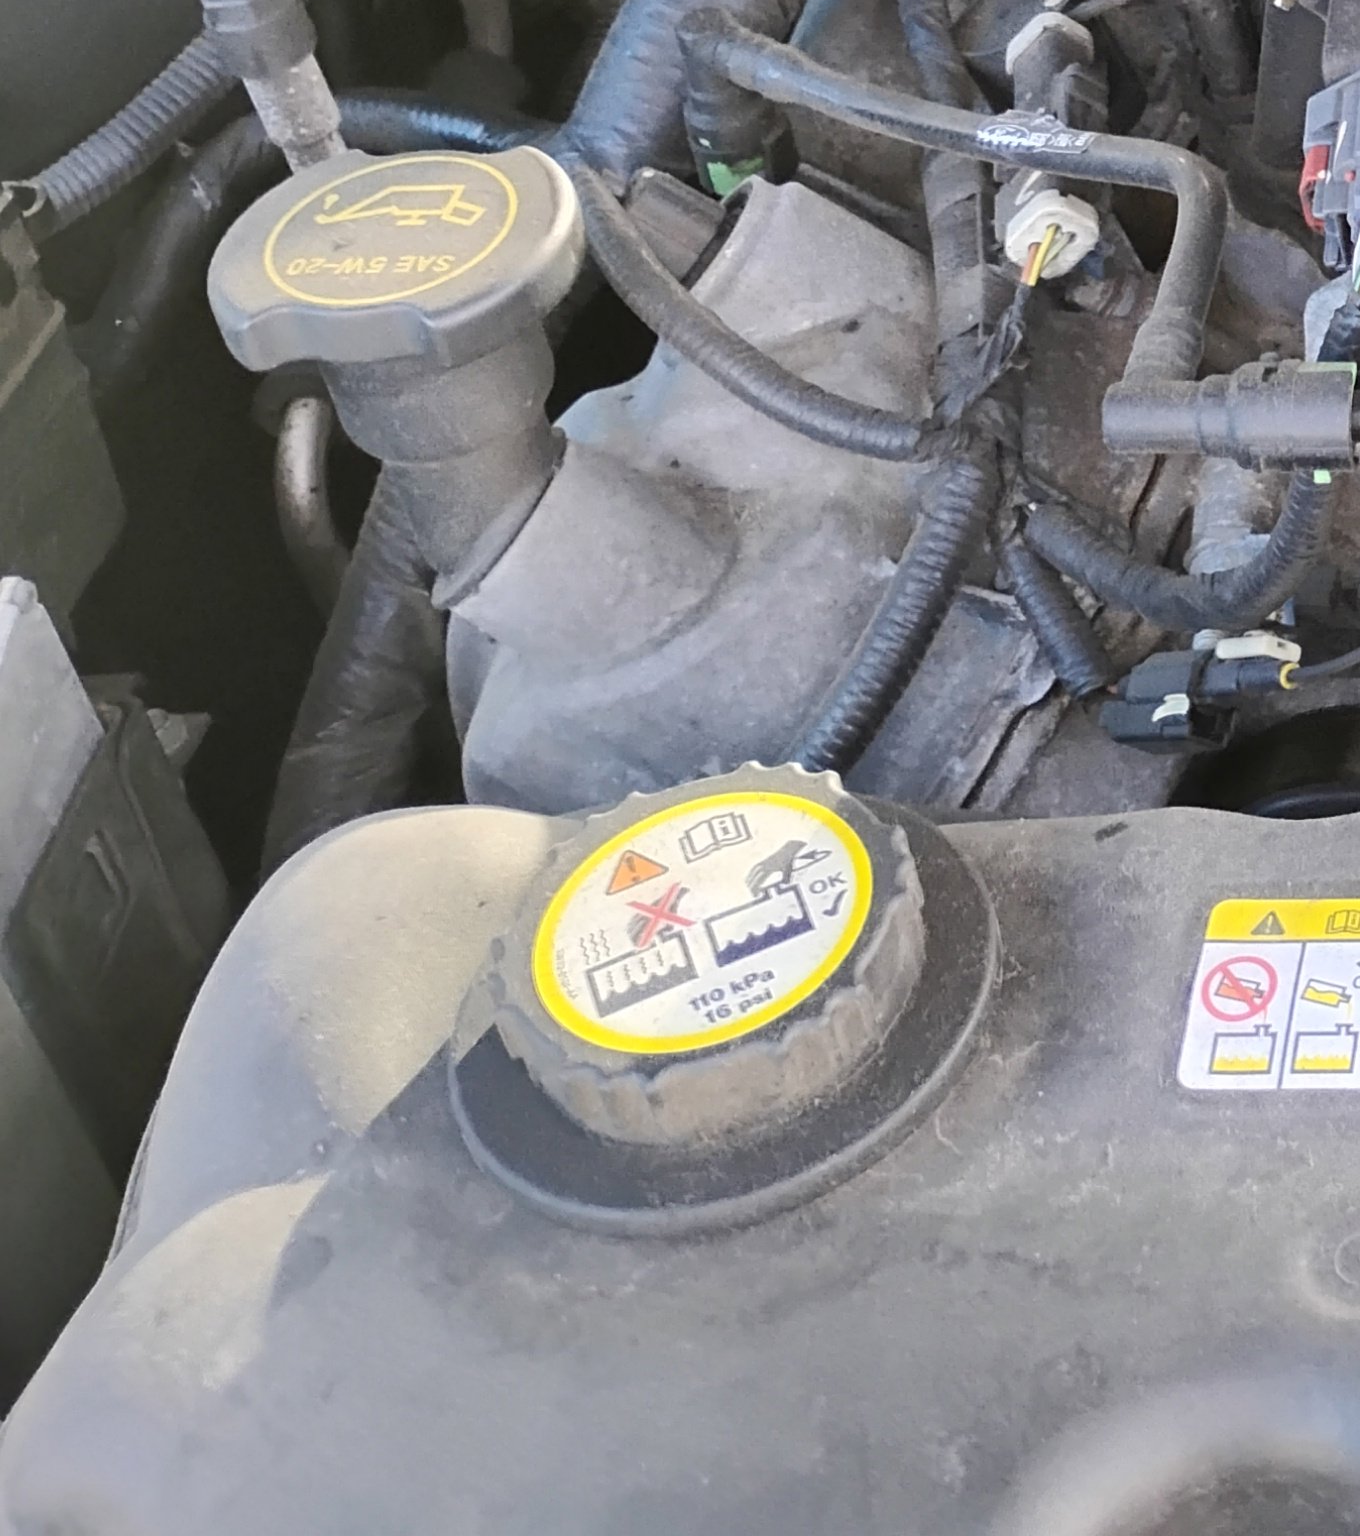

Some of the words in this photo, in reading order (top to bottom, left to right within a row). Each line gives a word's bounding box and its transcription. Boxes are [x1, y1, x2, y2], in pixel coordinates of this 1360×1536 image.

[287, 255, 387, 276] 5W-20
[396, 254, 455, 273] SAE
[807, 871, 848, 896] OK
[688, 988, 726, 1011] 110
[729, 969, 775, 994] kPa
[704, 1004, 733, 1024] 16
[738, 987, 774, 1013] psi
